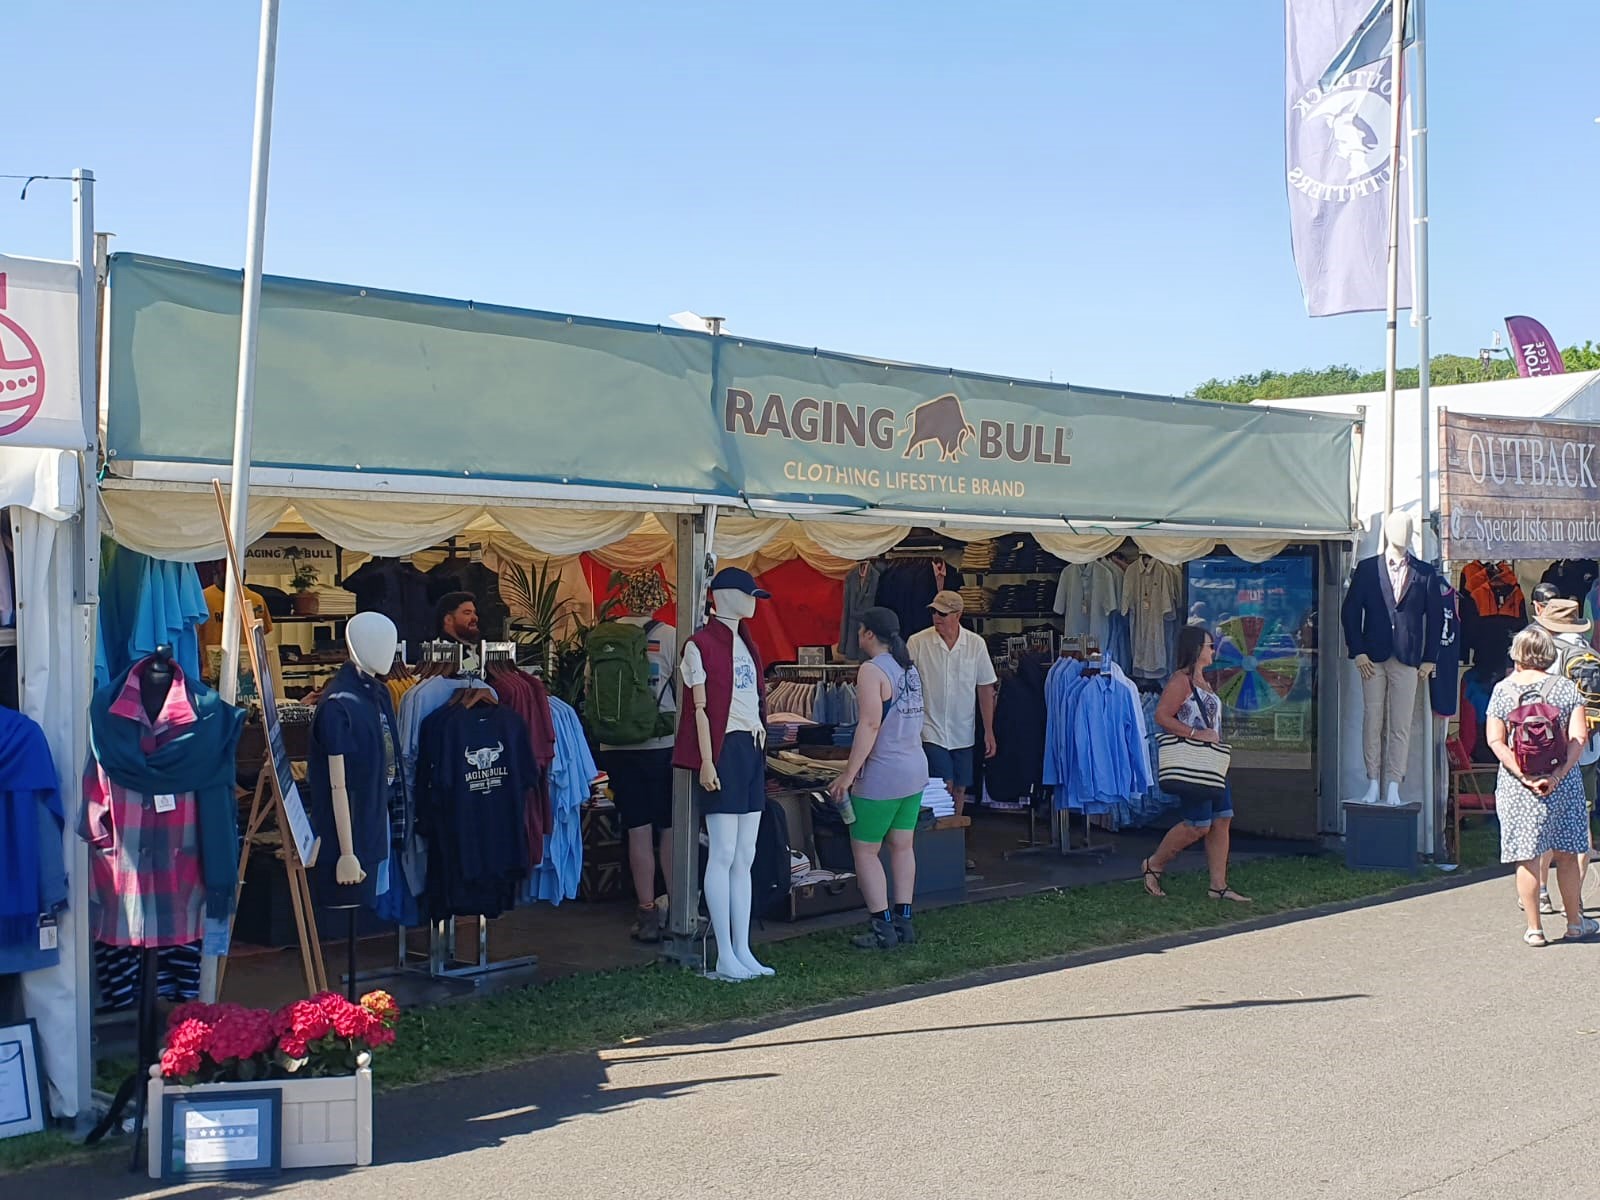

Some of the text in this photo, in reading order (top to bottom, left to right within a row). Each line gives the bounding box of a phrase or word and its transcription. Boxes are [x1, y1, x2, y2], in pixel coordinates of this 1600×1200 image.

[725, 387, 1073, 466] RAGING BULL
[783, 460, 1026, 498] CLOTHING LIFESTYLE BRAND
[1467, 433, 1598, 489] OUTBACK
[1474, 509, 1548, 551] Specialists
[1551, 511, 1564, 542] in
[244, 548, 333, 559] AGING BULL
